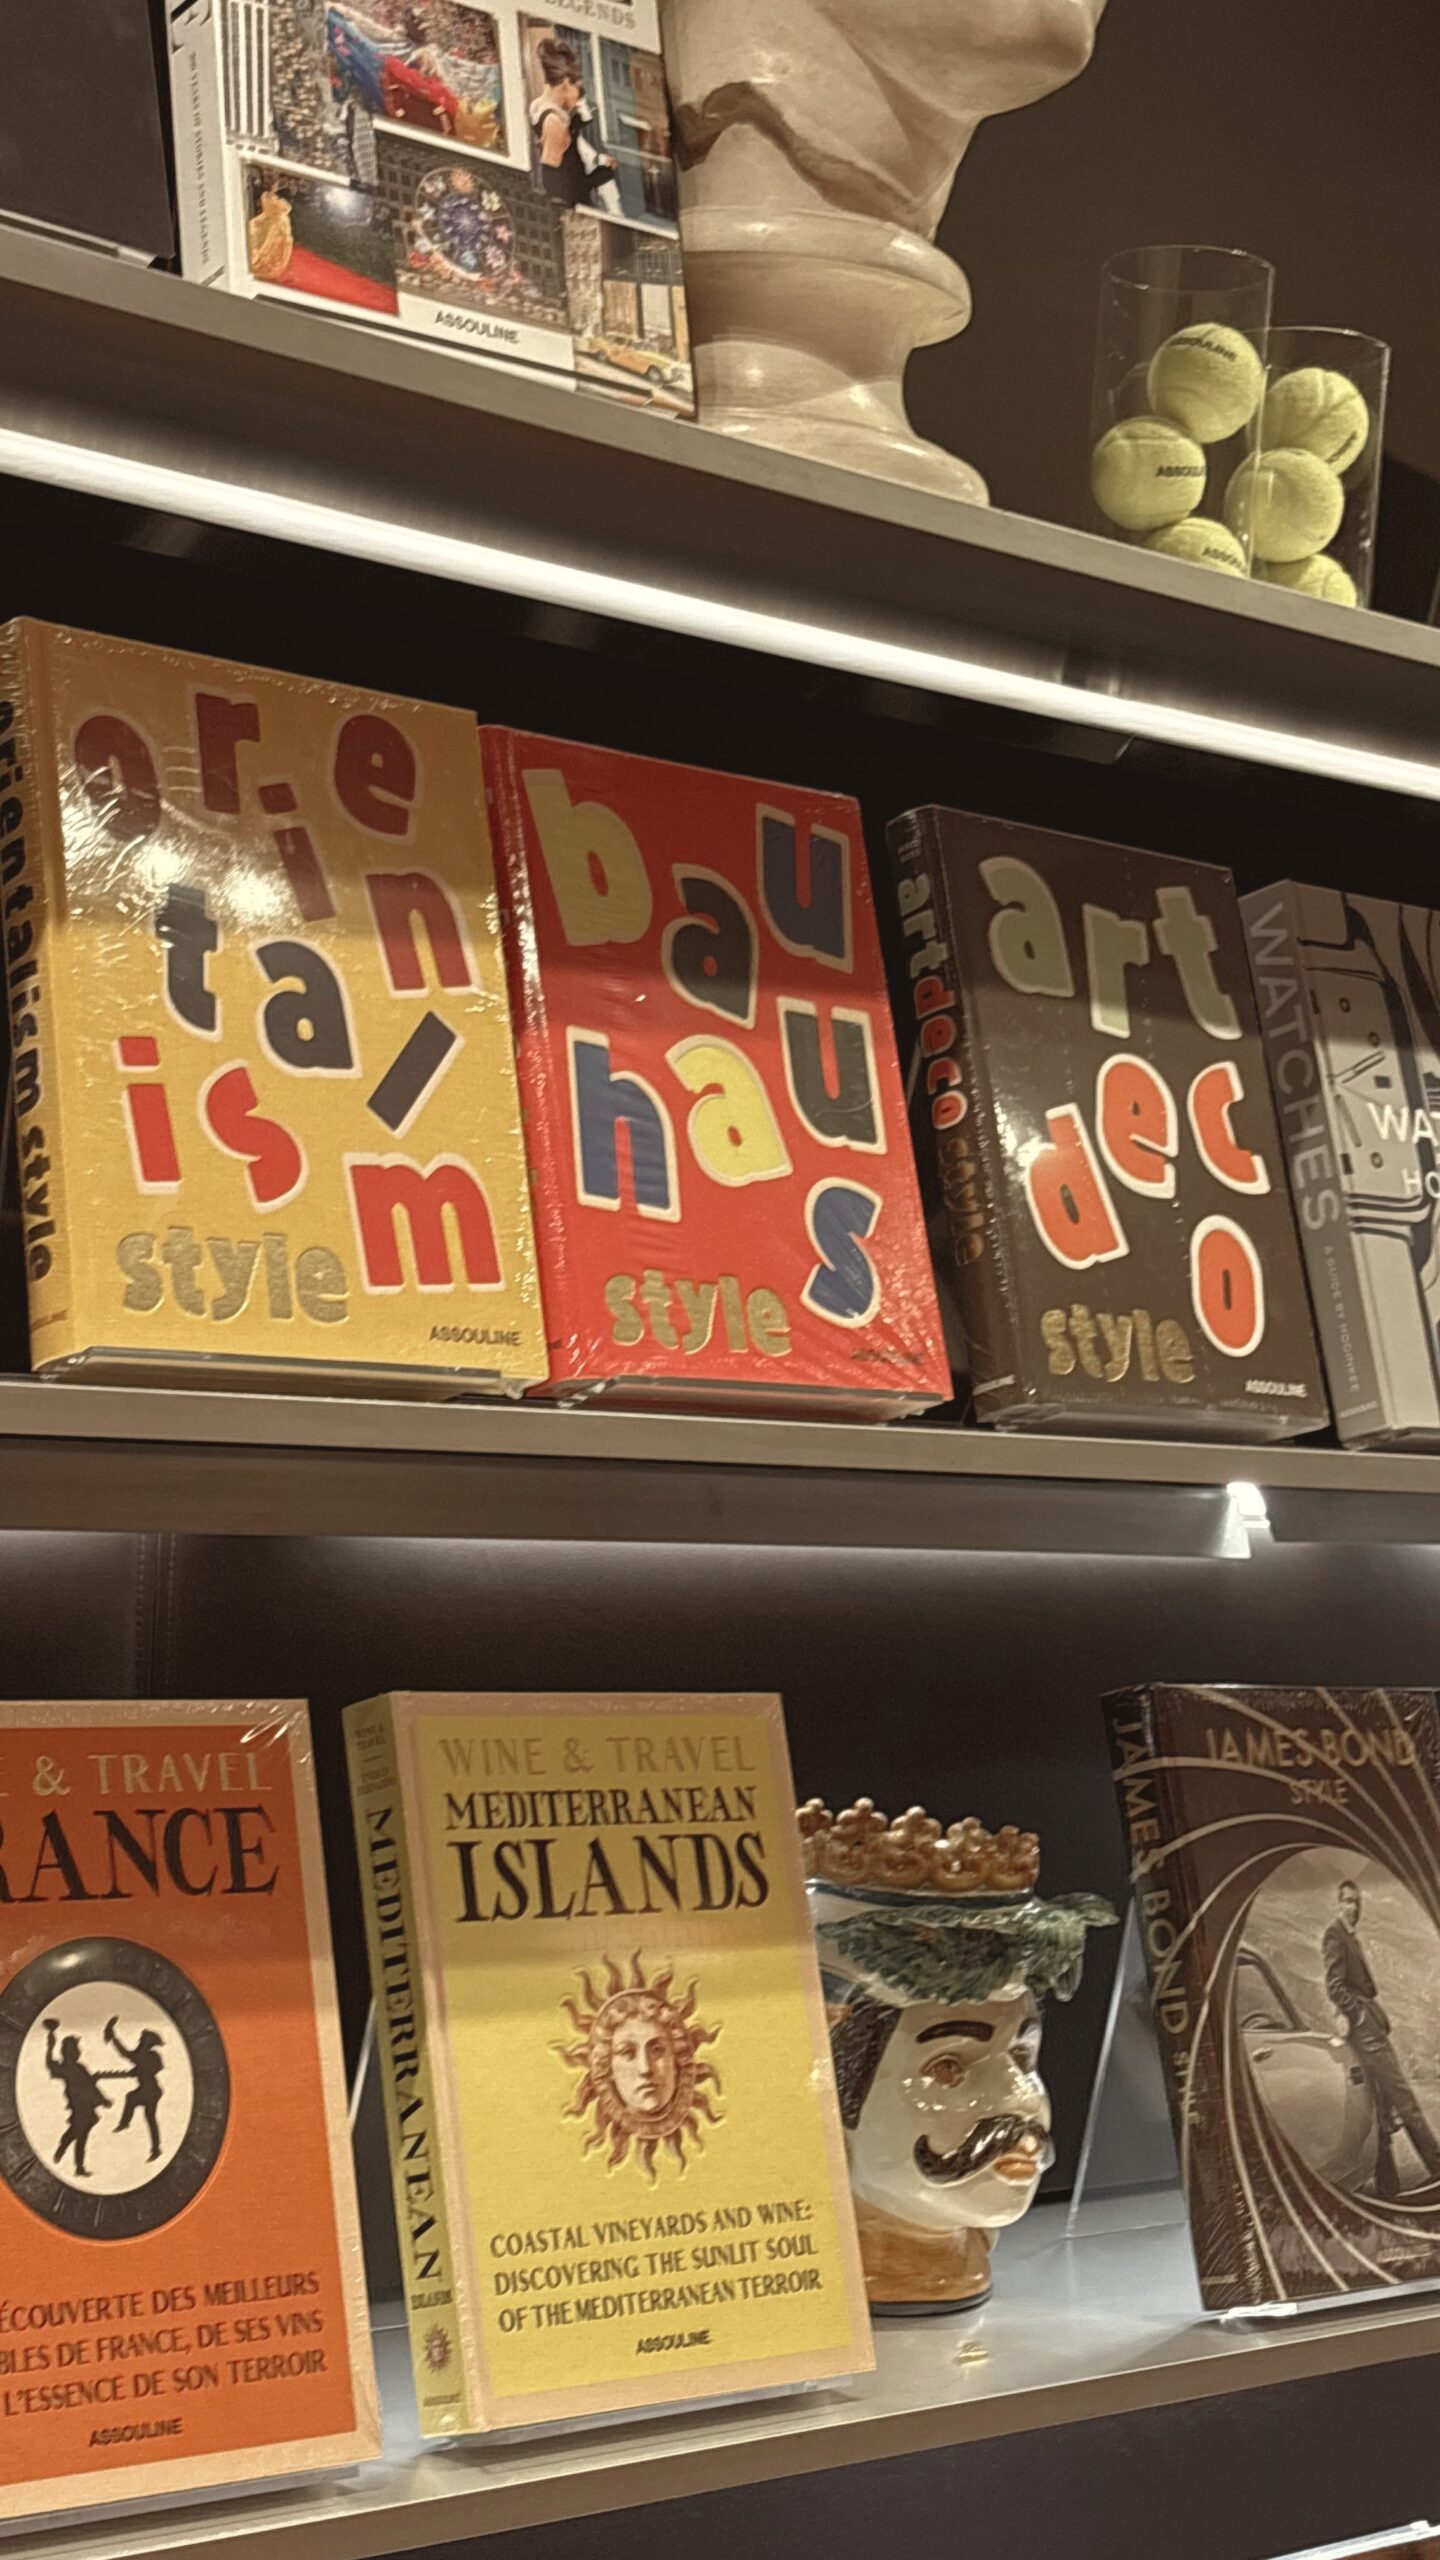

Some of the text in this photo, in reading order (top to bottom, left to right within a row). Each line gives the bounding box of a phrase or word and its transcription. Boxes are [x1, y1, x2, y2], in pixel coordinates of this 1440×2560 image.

[434, 309, 520, 344] ASSOULINE
[898, 872, 949, 978] art
[978, 856, 1243, 1040] art
[914, 975, 968, 1130] deco
[1250, 901, 1339, 1231] WATCHES
[116, 1225, 351, 1325] style
[429, 1325, 523, 1347] ASSOULINE
[604, 1268, 793, 1358] style
[1040, 1304, 1197, 1384] style
[87, 1752, 273, 1795] TRAVEL
[440, 1735, 757, 1778] WINE & TRAVEL
[1205, 1727, 1416, 1768] JAMES BOND
[443, 1785, 758, 1831] MEDITERRANEAN
[1290, 1778, 1349, 1805] STYLE
[446, 1831, 770, 1923] ISLANDS
[1113, 1718, 1165, 1873] JAMES
[1142, 1889, 1189, 2034] BOND
[366, 1805, 443, 2282] MEDITERRANEAN
[490, 2199, 814, 2258] COASTAL VINEYARDS AND WINE:
[152, 2286, 197, 2315] DES
[203, 2271, 321, 2307] MEILLEURS
[494, 2233, 820, 2296] DISCOVERING THE SUNLIT SOUL
[498, 2268, 824, 2333] OF THE MEDITERRANEAN TERROIR
[56, 2338, 91, 2368] DE
[96, 2327, 191, 2363] FRANCE,
[196, 2321, 229, 2349] DE
[234, 2316, 271, 2343] SES
[275, 2309, 324, 2337] VINS
[636, 2328, 712, 2355] ASSOULINE
[4, 2348, 329, 2417] L'ESSENCE DE SON TERROIR
[88, 2417, 184, 2447] ASSOULINE
